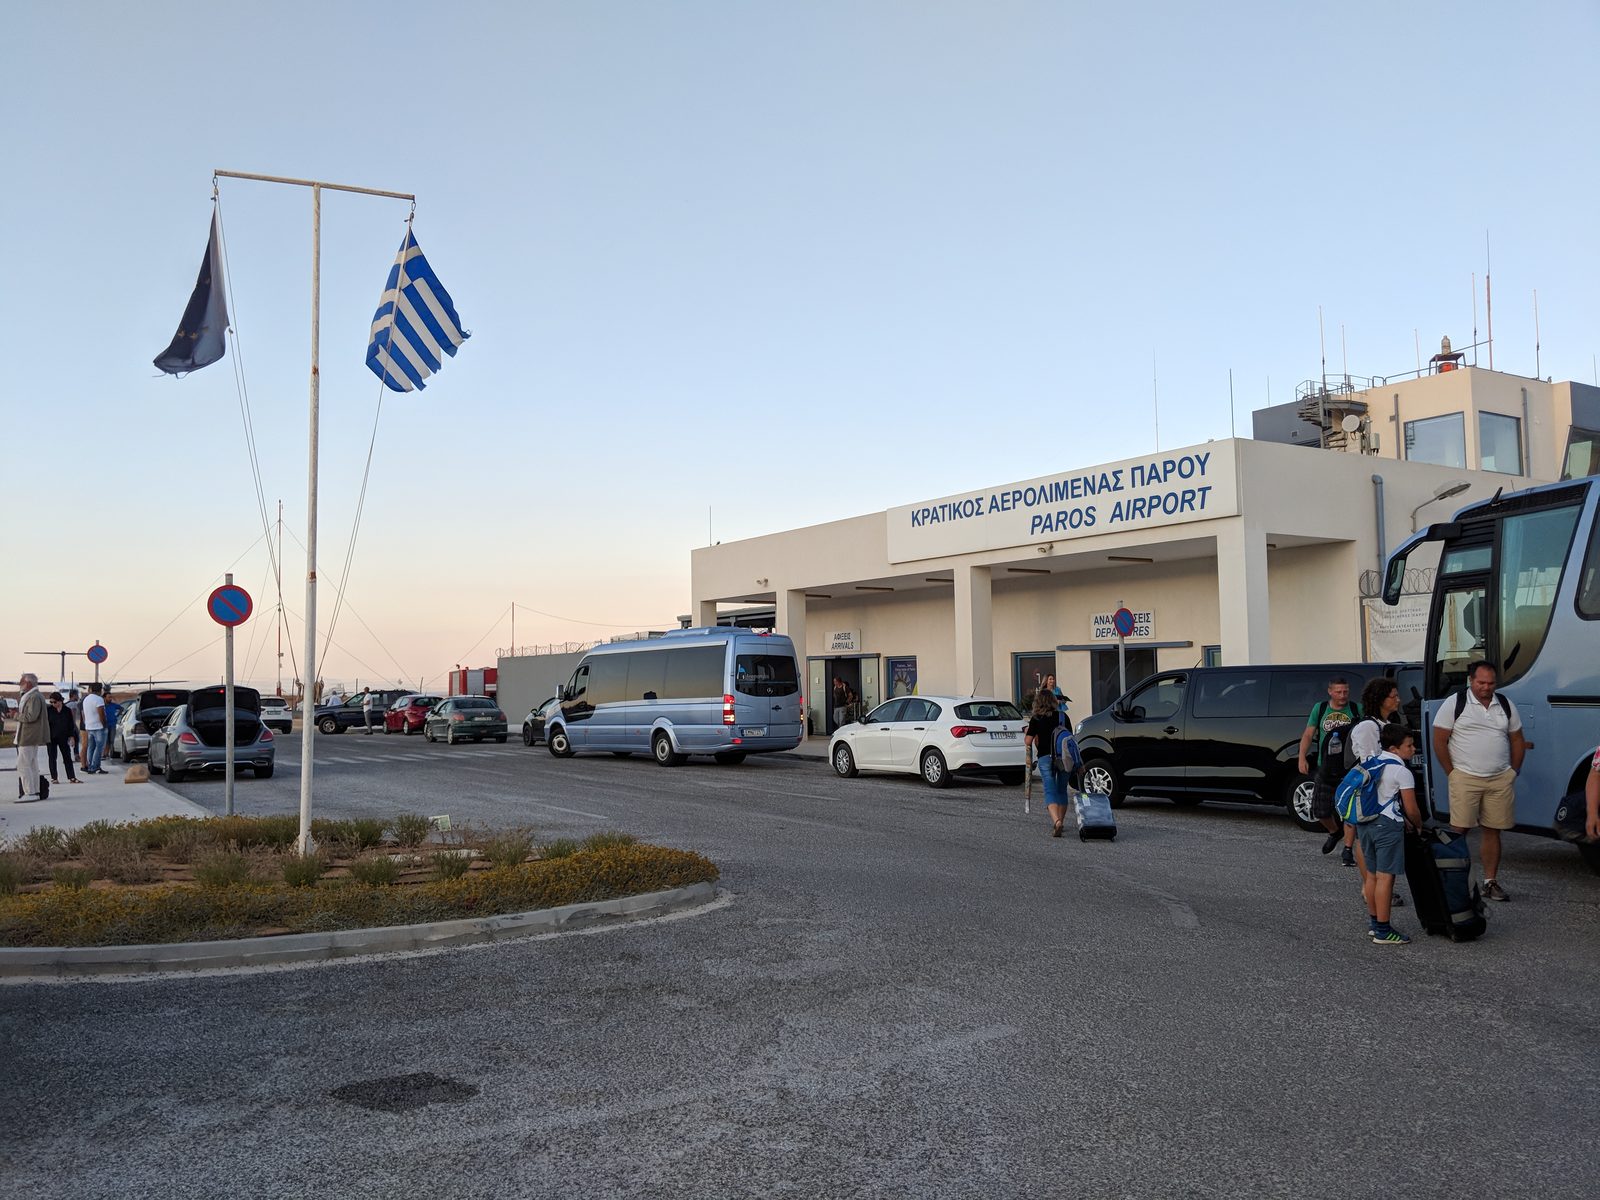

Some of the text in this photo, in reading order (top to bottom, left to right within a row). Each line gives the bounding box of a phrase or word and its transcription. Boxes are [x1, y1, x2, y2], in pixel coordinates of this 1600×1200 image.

[911, 452, 1211, 528] ΚΡΑΤΙΚΟΣ ΑΕΡΟΛΙΜΕΝΑΣ ΠΑΡΟΥ
[1030, 486, 1212, 535] PAROS AIRPORT
[831, 641, 854, 650] ARRIVALS
[1095, 625, 1150, 638] DEPARES
